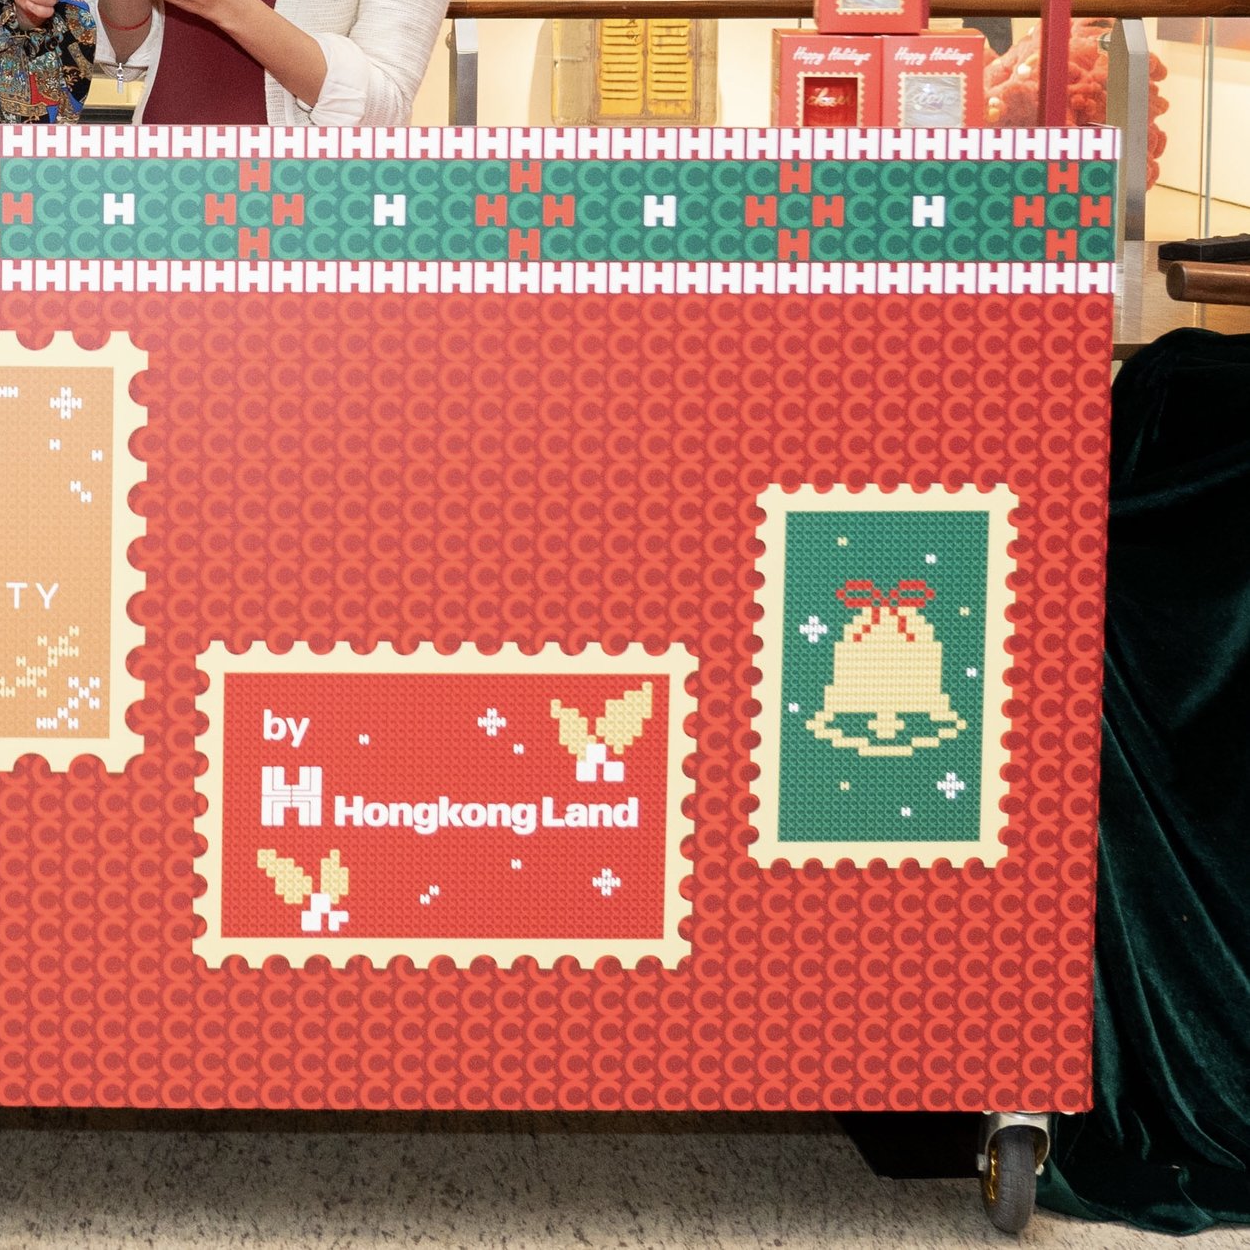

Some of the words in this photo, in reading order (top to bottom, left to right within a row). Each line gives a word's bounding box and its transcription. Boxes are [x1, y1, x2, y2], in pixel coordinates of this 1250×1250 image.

[793, 46, 825, 65] Happy
[828, 46, 872, 66] Holidays
[894, 46, 926, 65] Happy
[929, 47, 974, 66] Holidays
[263, 709, 310, 748] by
